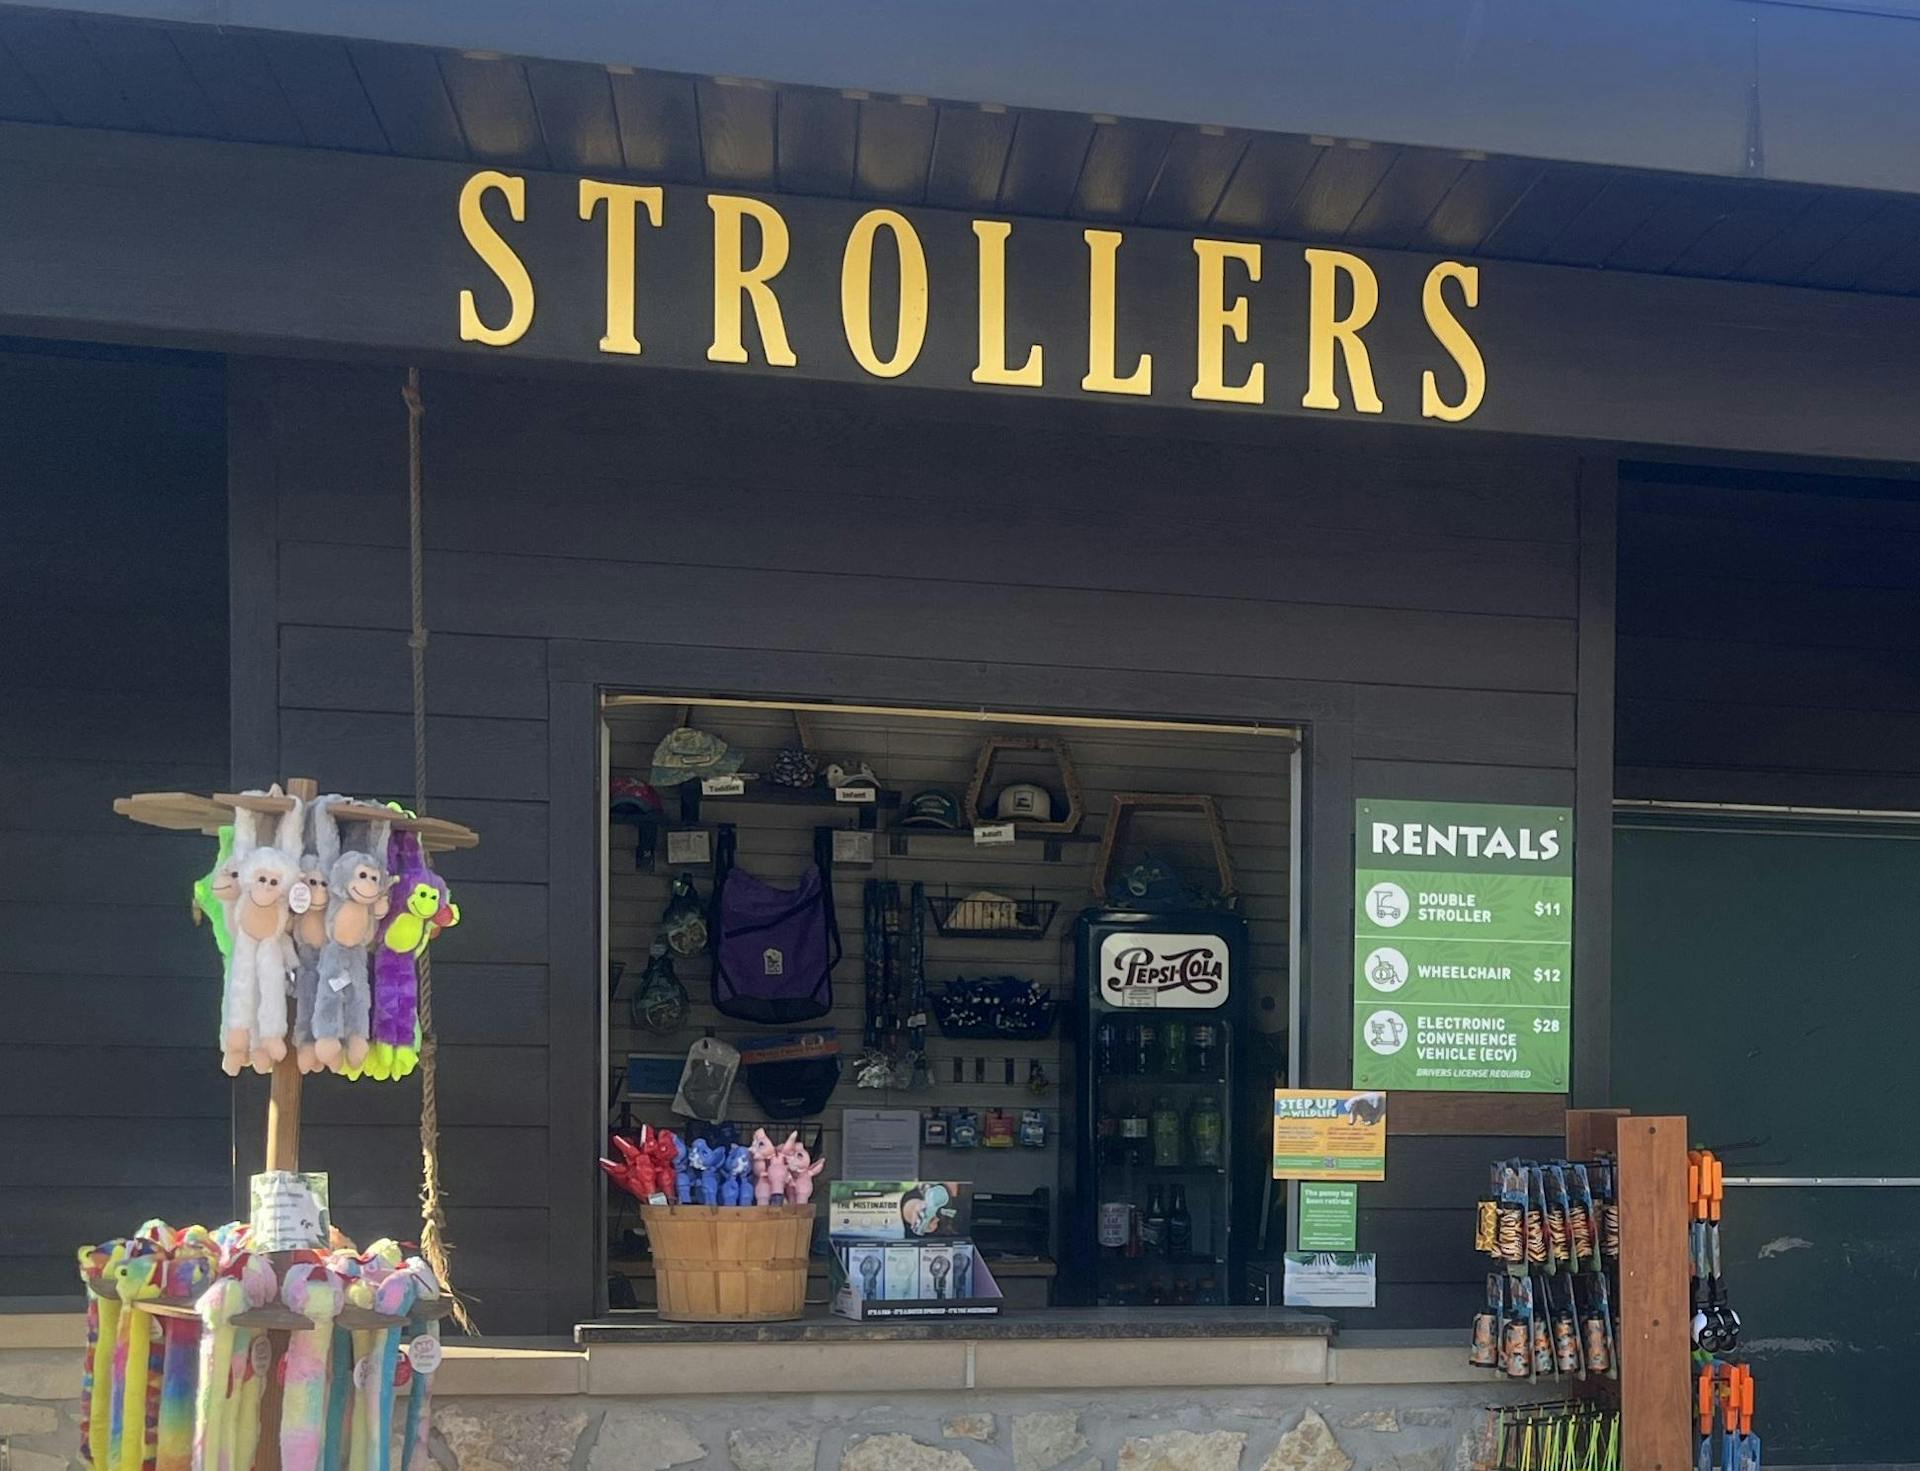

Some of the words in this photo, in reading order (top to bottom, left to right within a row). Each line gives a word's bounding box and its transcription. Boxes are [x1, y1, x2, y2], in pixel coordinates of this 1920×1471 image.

[458, 169, 1487, 422] STROLLERS
[1371, 821, 1561, 861] RENTALS
[1418, 892, 1476, 908] DOUBLE
[1418, 908, 1492, 923] STROLLER
[1534, 901, 1561, 917] $11
[1417, 965, 1511, 980] WHEELCHAIR
[1533, 967, 1561, 983] $12
[1417, 1016, 1506, 1031] ELECTRONIC
[1532, 1018, 1560, 1034] $28
[1416, 1032, 1517, 1046] CONVENIENCE
[1416, 1047, 1477, 1061] VEHICLE
[1480, 1048, 1518, 1063] (ECV)
[1453, 1069, 1488, 1078] LICENSE
[1489, 1070, 1532, 1079] REQUIRED
[1279, 1098, 1314, 1110] STEP
[1315, 1098, 1338, 1110] UP
[1291, 1109, 1338, 1118] WILDLIFE
